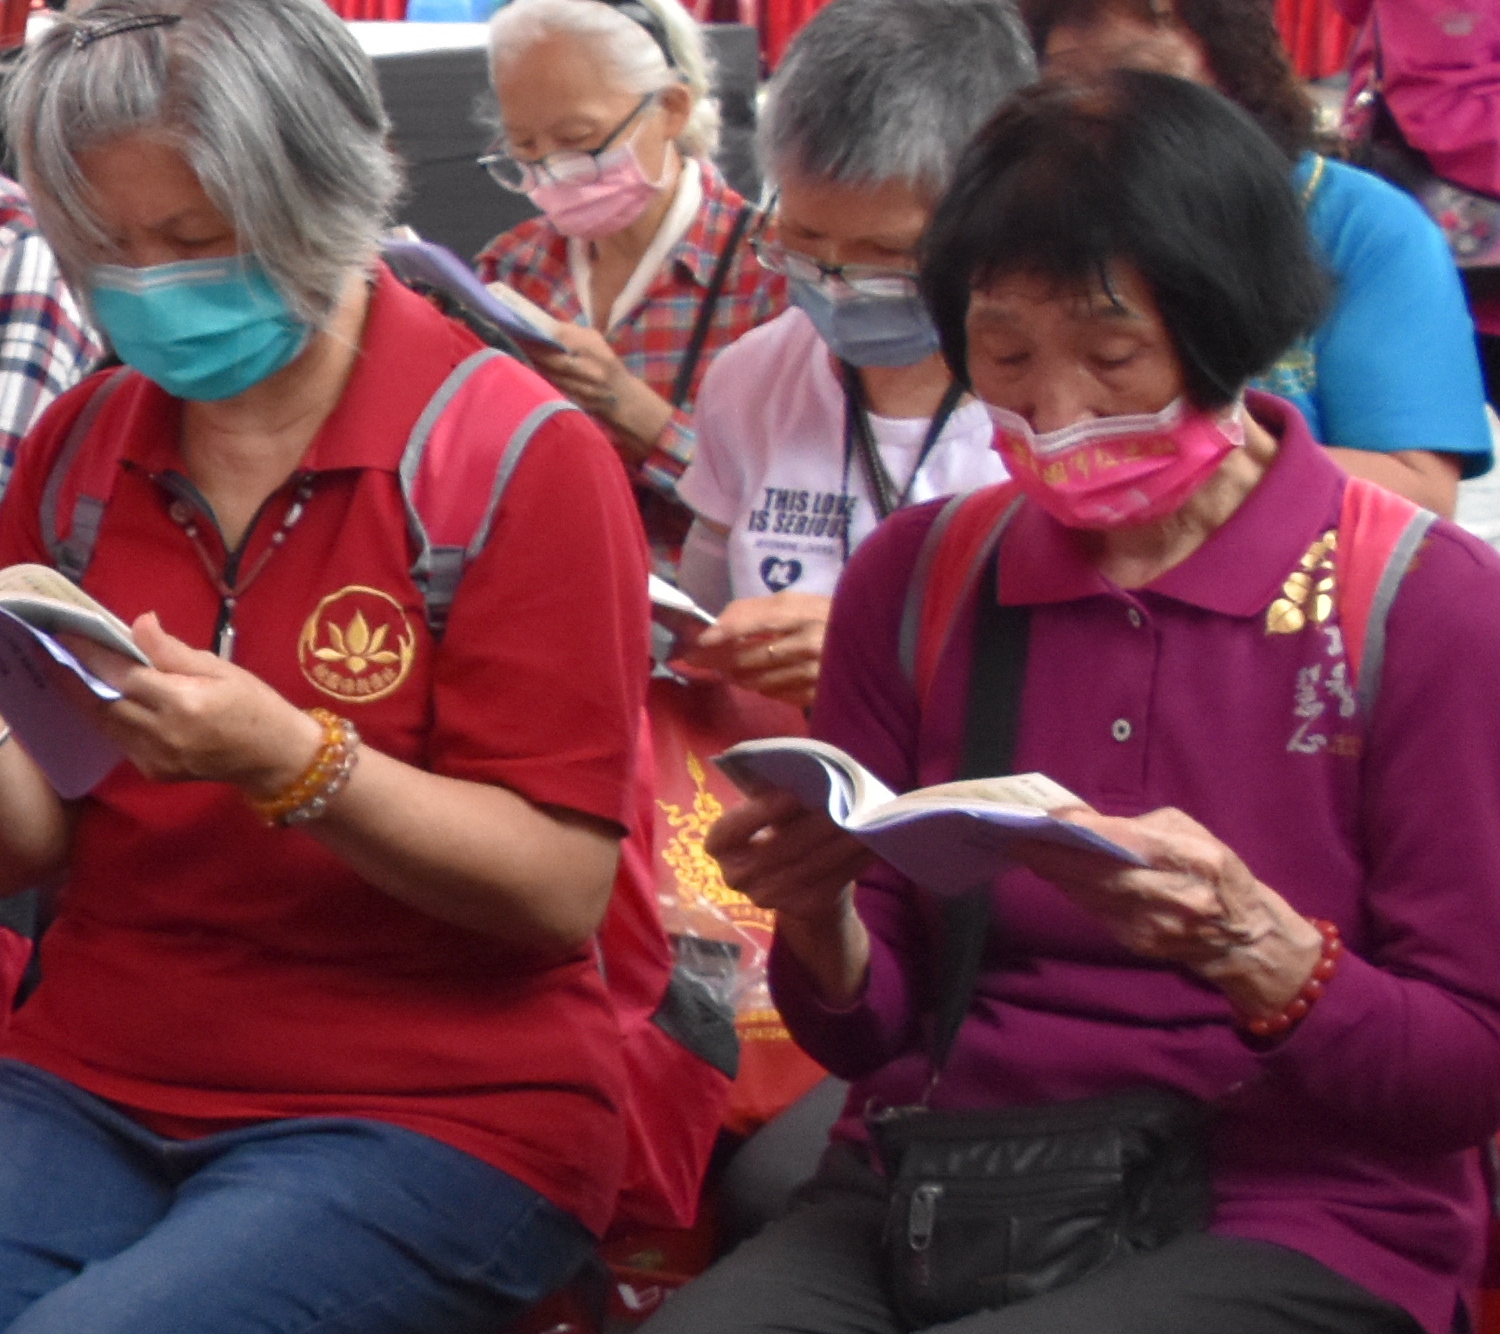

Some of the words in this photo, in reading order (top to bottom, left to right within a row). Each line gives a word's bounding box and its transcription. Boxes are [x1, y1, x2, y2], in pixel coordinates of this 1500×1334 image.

[764, 487, 809, 513] THIS
[749, 510, 769, 533] IS
[773, 511, 852, 537] SERIOU
